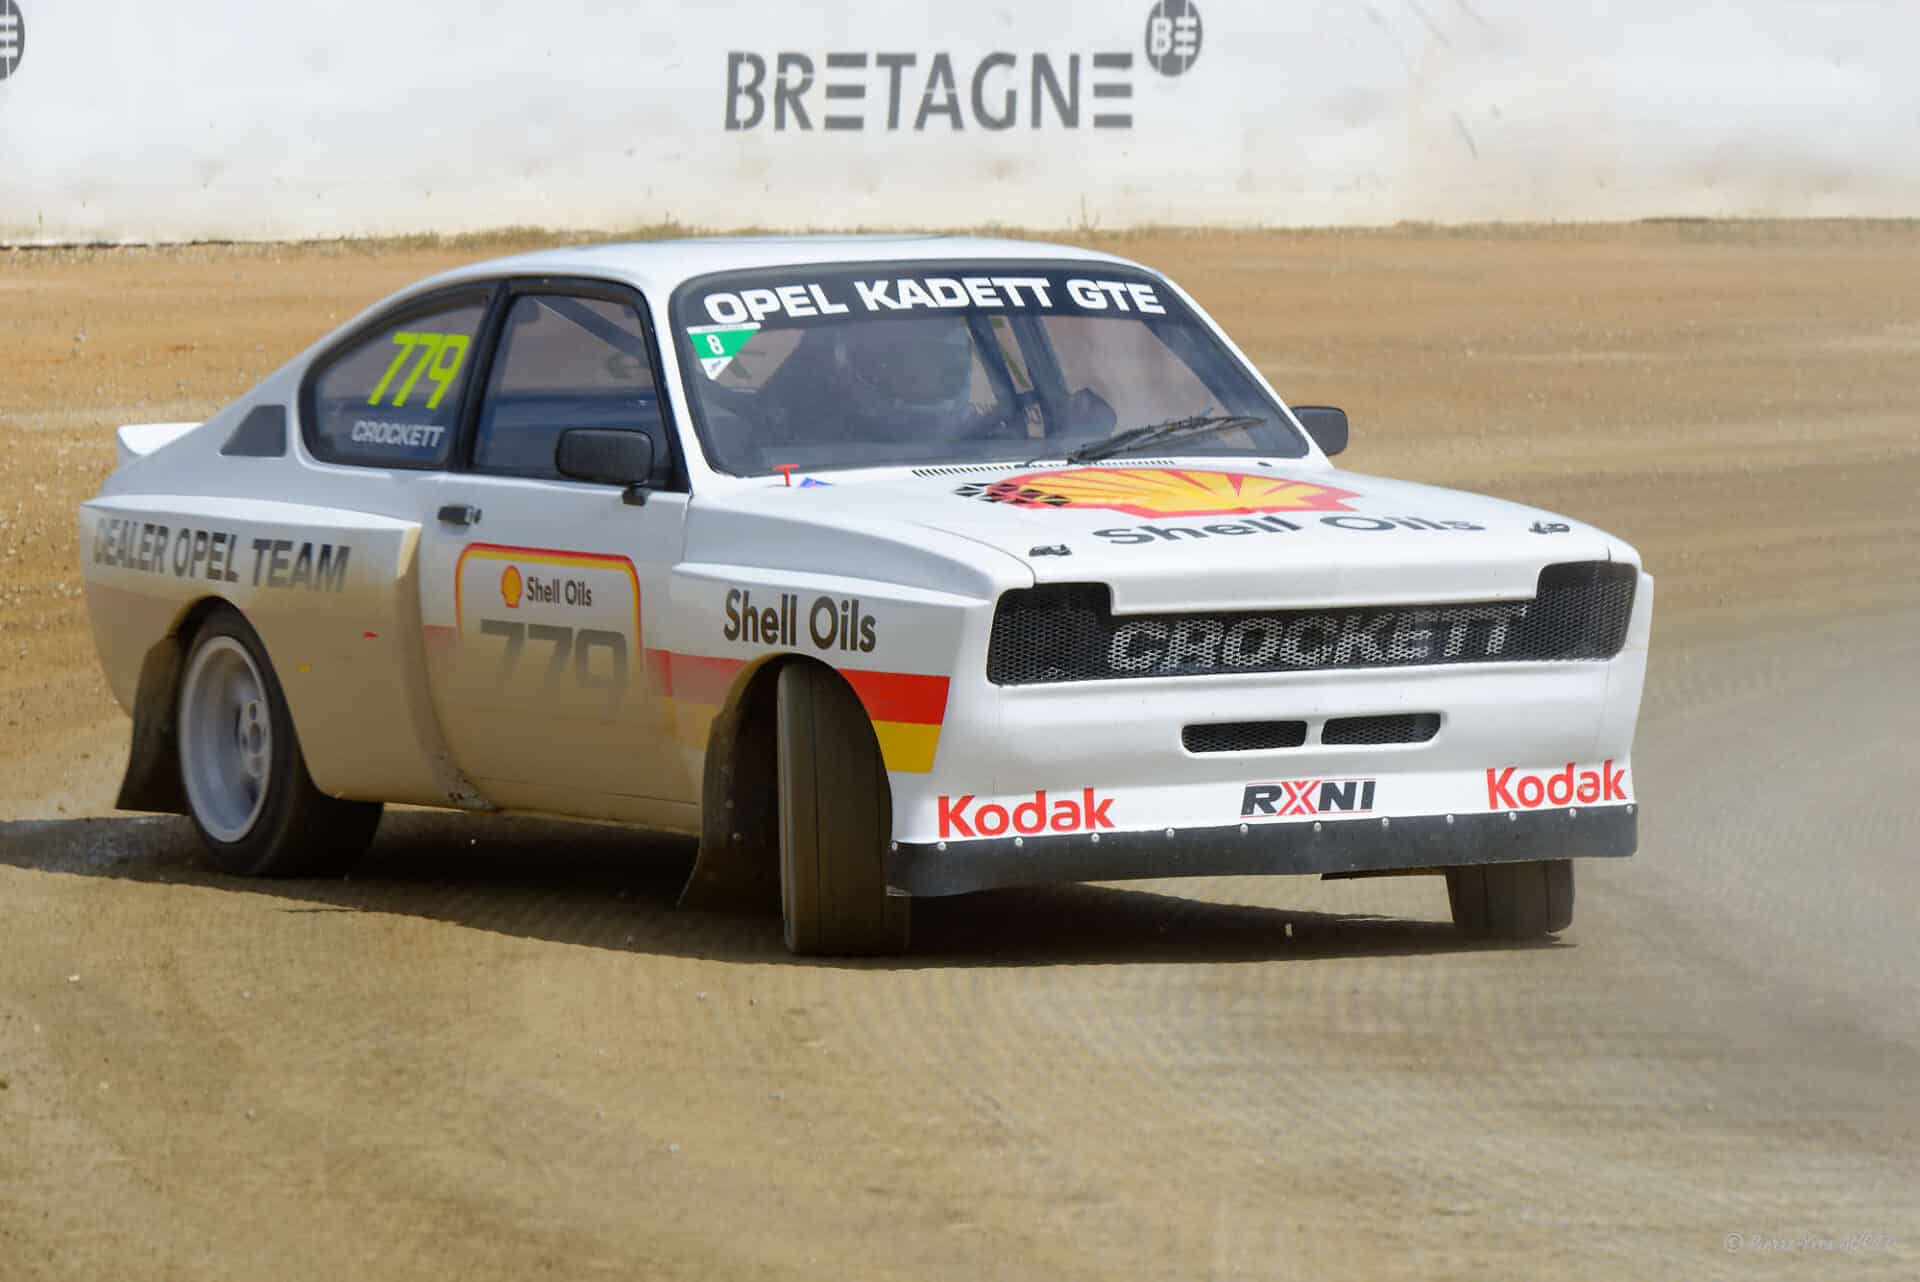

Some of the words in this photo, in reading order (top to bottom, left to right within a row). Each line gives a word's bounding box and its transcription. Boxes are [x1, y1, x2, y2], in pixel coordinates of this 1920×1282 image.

[724, 51, 1133, 131] BRETAGNE
[704, 285, 849, 325] OPEL
[854, 278, 1053, 310] KADETT
[1066, 279, 1166, 315] GTE
[368, 332, 470, 410] 779
[351, 420, 445, 447] CROCKETT
[1093, 515, 1301, 545] Shell
[1320, 513, 1485, 531] Oils
[173, 527, 238, 583] OPEL
[252, 537, 352, 592] TEAM
[527, 576, 560, 604] Shell
[565, 580, 592, 607] Oils
[723, 588, 798, 646] Shell
[809, 596, 876, 653] Oils
[1107, 605, 1527, 672] CROCKETT
[1486, 758, 1627, 810] Kodak
[937, 788, 1115, 838] Kodak
